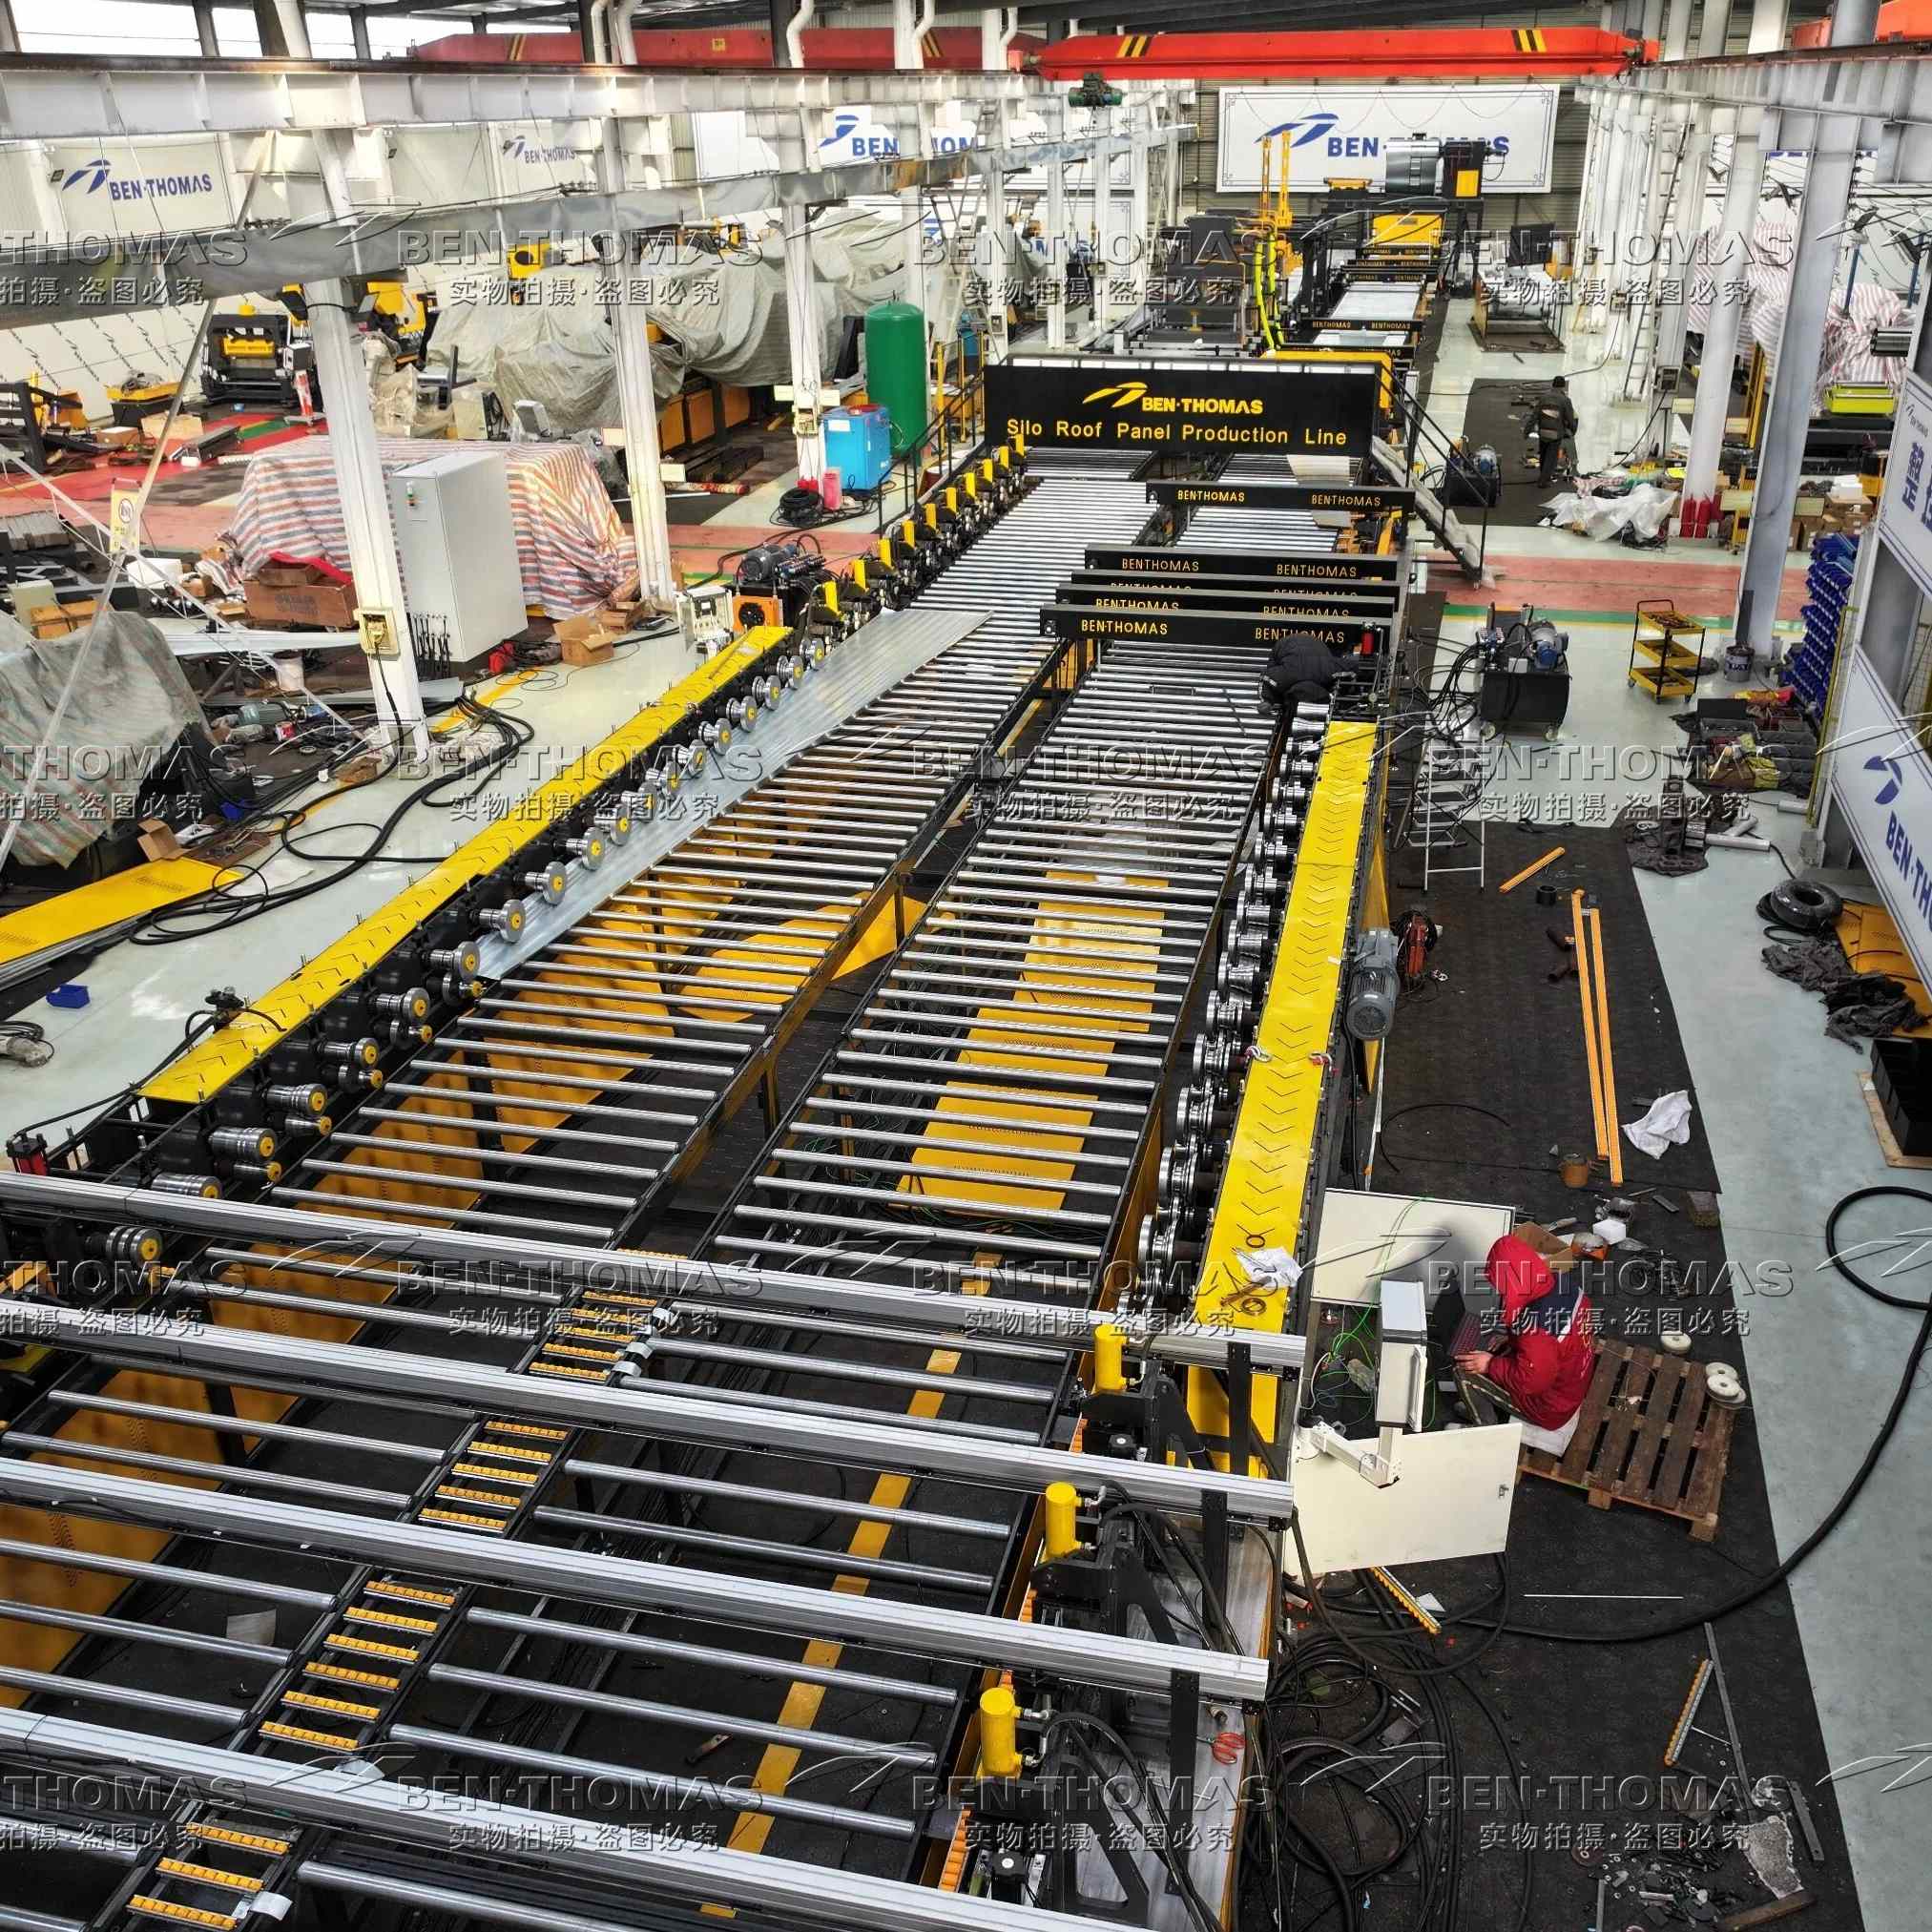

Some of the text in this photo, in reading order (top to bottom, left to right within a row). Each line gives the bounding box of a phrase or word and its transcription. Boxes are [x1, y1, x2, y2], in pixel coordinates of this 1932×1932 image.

[1142, 396, 1263, 414] BEN·THOMAS
[1007, 418, 1347, 446] Silo Roof Panel Production Line
